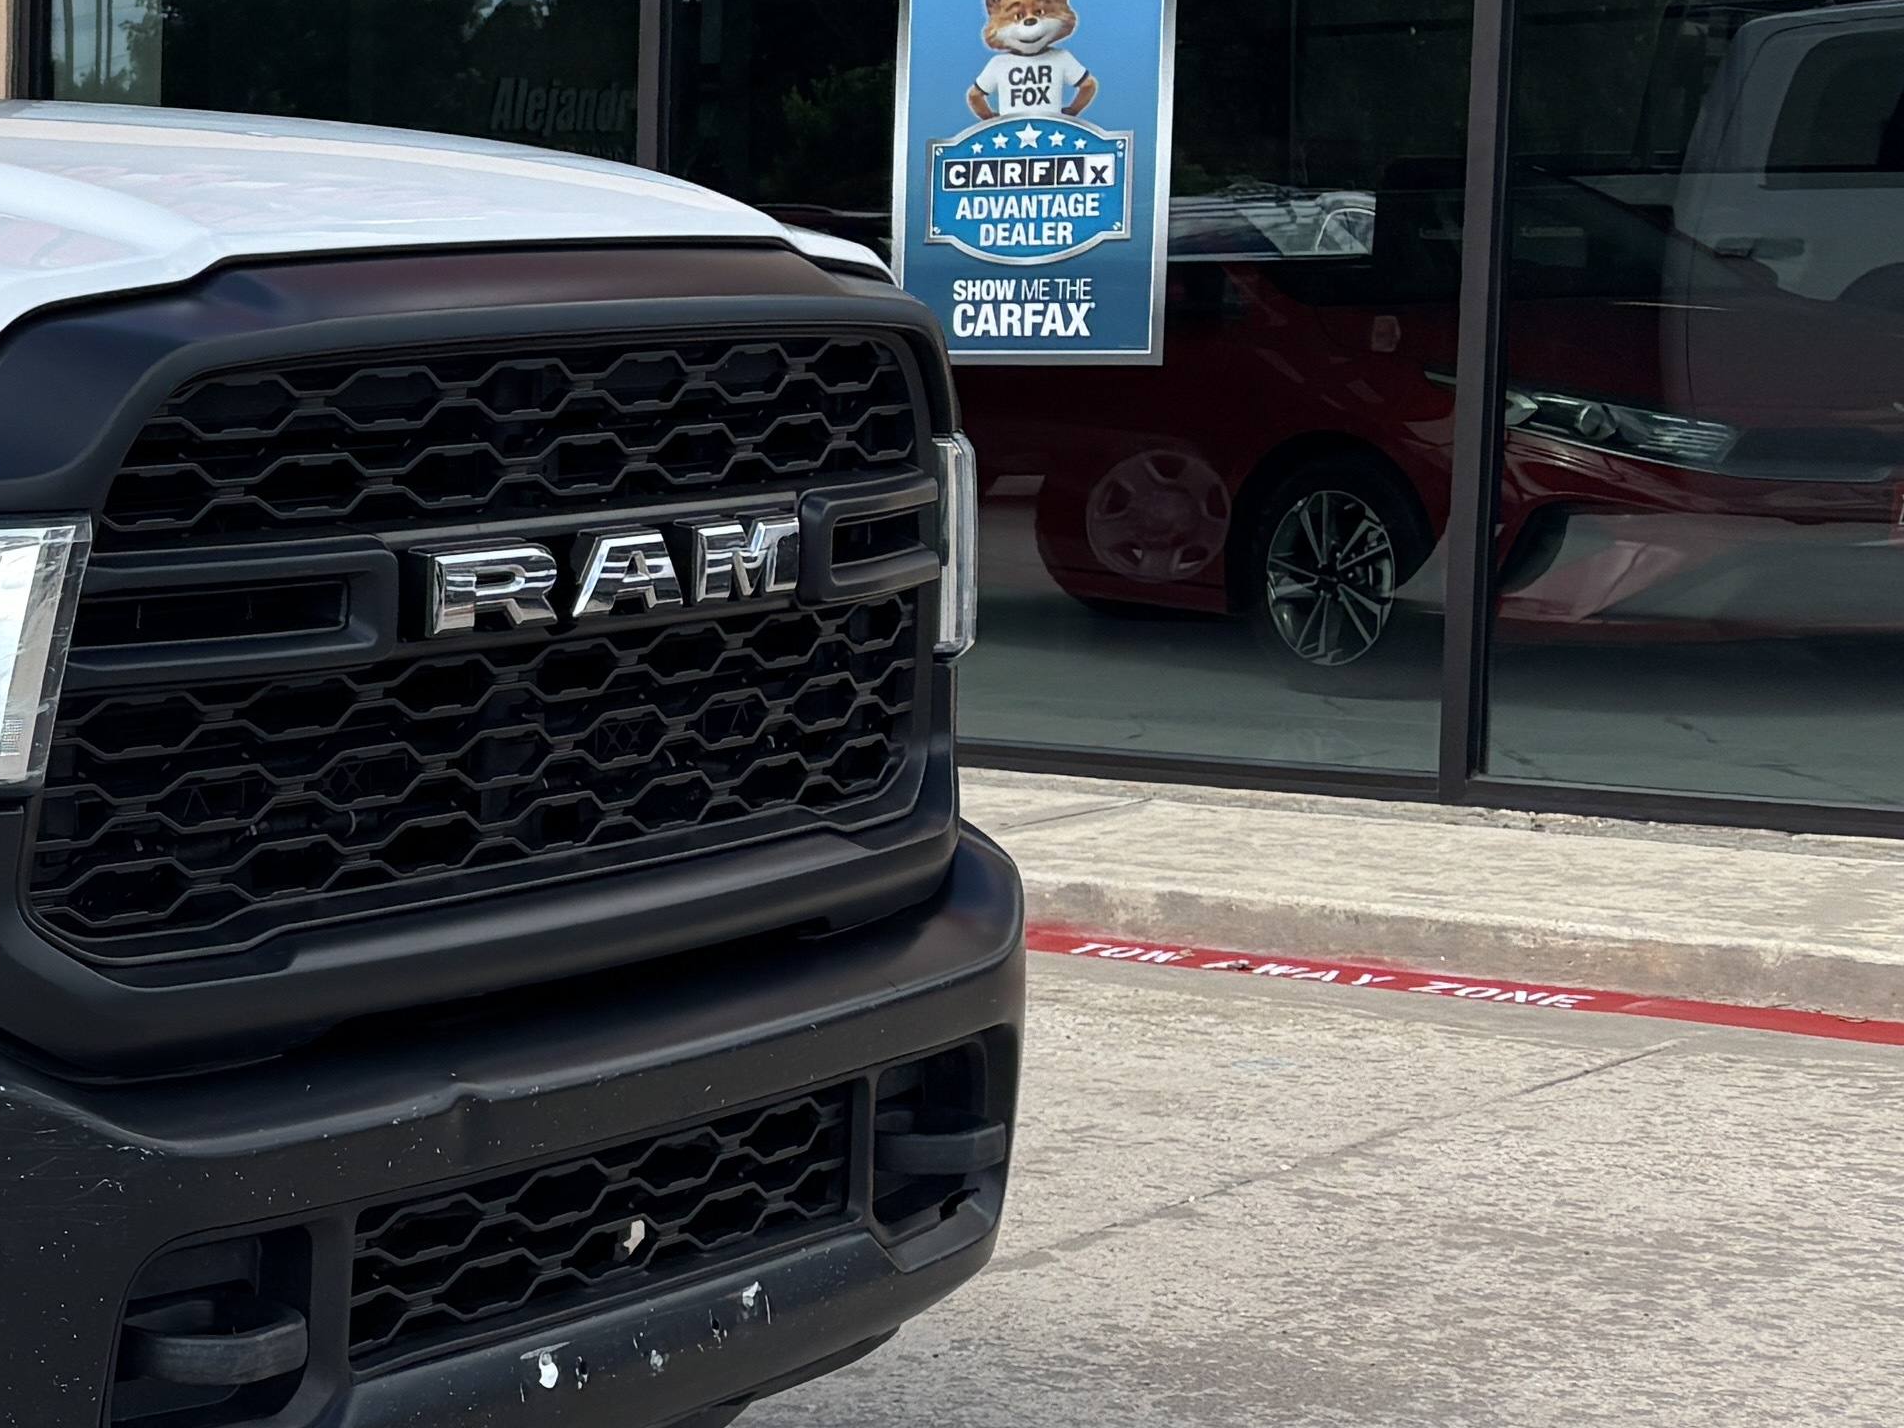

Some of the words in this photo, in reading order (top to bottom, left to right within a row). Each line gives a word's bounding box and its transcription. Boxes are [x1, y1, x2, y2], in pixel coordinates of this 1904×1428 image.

[1007, 64, 1053, 87] CAR
[1009, 85, 1052, 107] FOX
[947, 159, 1111, 188] CARFAX
[955, 191, 1101, 220] ADVANTAGE
[978, 220, 1074, 247] DEALER
[952, 279, 1016, 301] SHOW
[1020, 279, 1049, 299] ME
[1053, 277, 1092, 298] THE
[952, 302, 1092, 338] CARFAX
[409, 513, 801, 639] RAM
[1070, 942, 1191, 964] TOW
[1408, 980, 1597, 1011] ZONE
